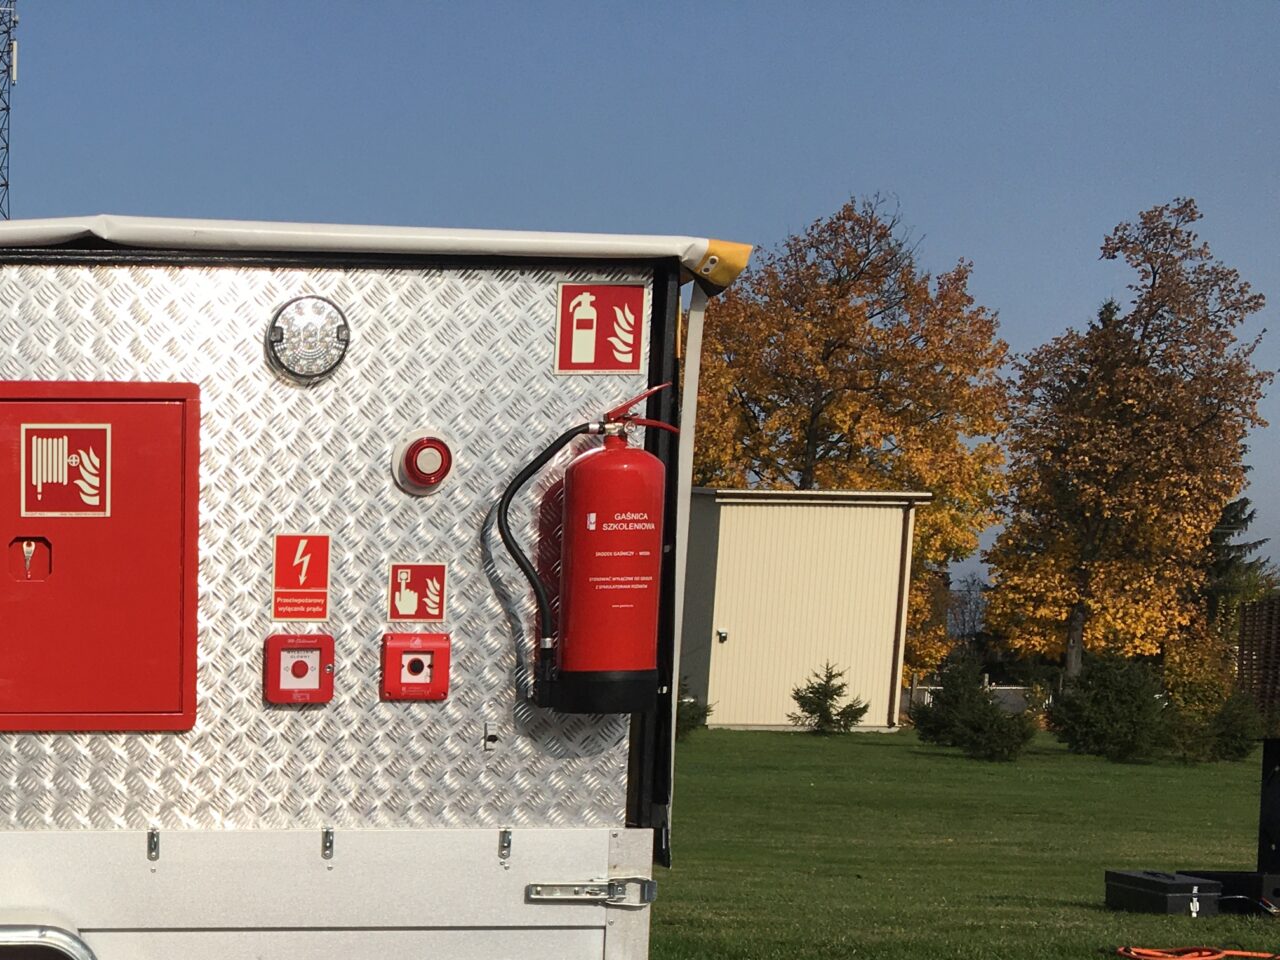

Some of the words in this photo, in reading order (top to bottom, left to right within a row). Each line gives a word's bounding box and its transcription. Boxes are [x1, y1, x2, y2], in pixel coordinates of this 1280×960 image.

[614, 511, 648, 521] GAŚNICA
[602, 522, 656, 531] SZKOLENIOWA
[276, 596, 325, 605] Przeciwpożarowy
[278, 605, 306, 613] wyłącznik
[306, 605, 323, 613] prądu
